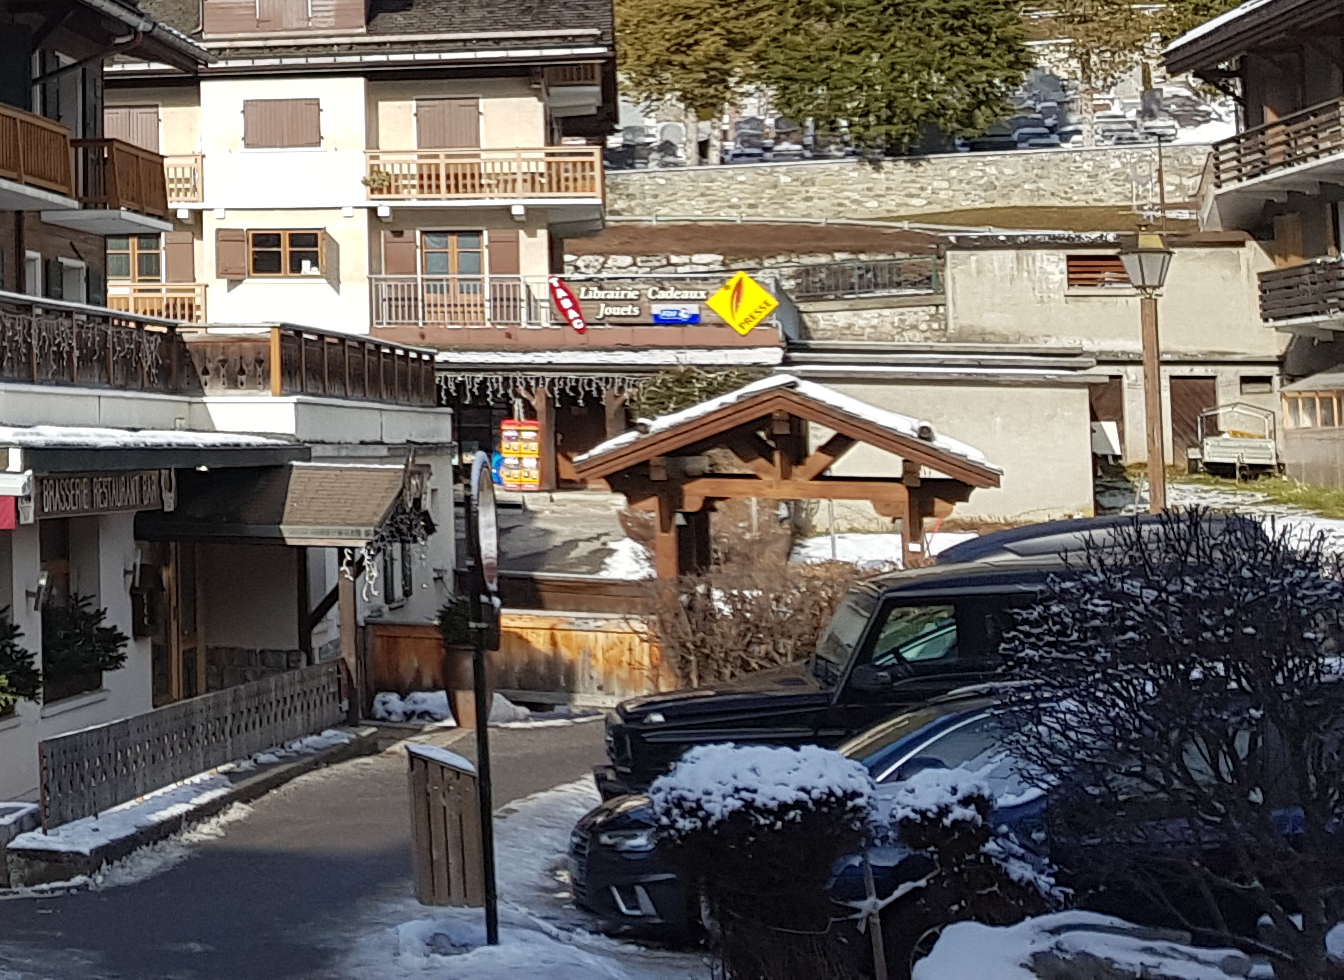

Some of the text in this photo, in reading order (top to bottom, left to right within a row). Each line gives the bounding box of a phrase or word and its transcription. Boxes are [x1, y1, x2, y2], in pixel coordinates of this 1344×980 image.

[549, 277, 585, 329] TABAC
[579, 286, 708, 301] Librairie Cadeaux
[596, 303, 641, 319] Jouets
[739, 299, 772, 330] PRESSE
[92, 475, 140, 508] RESTAURANT
